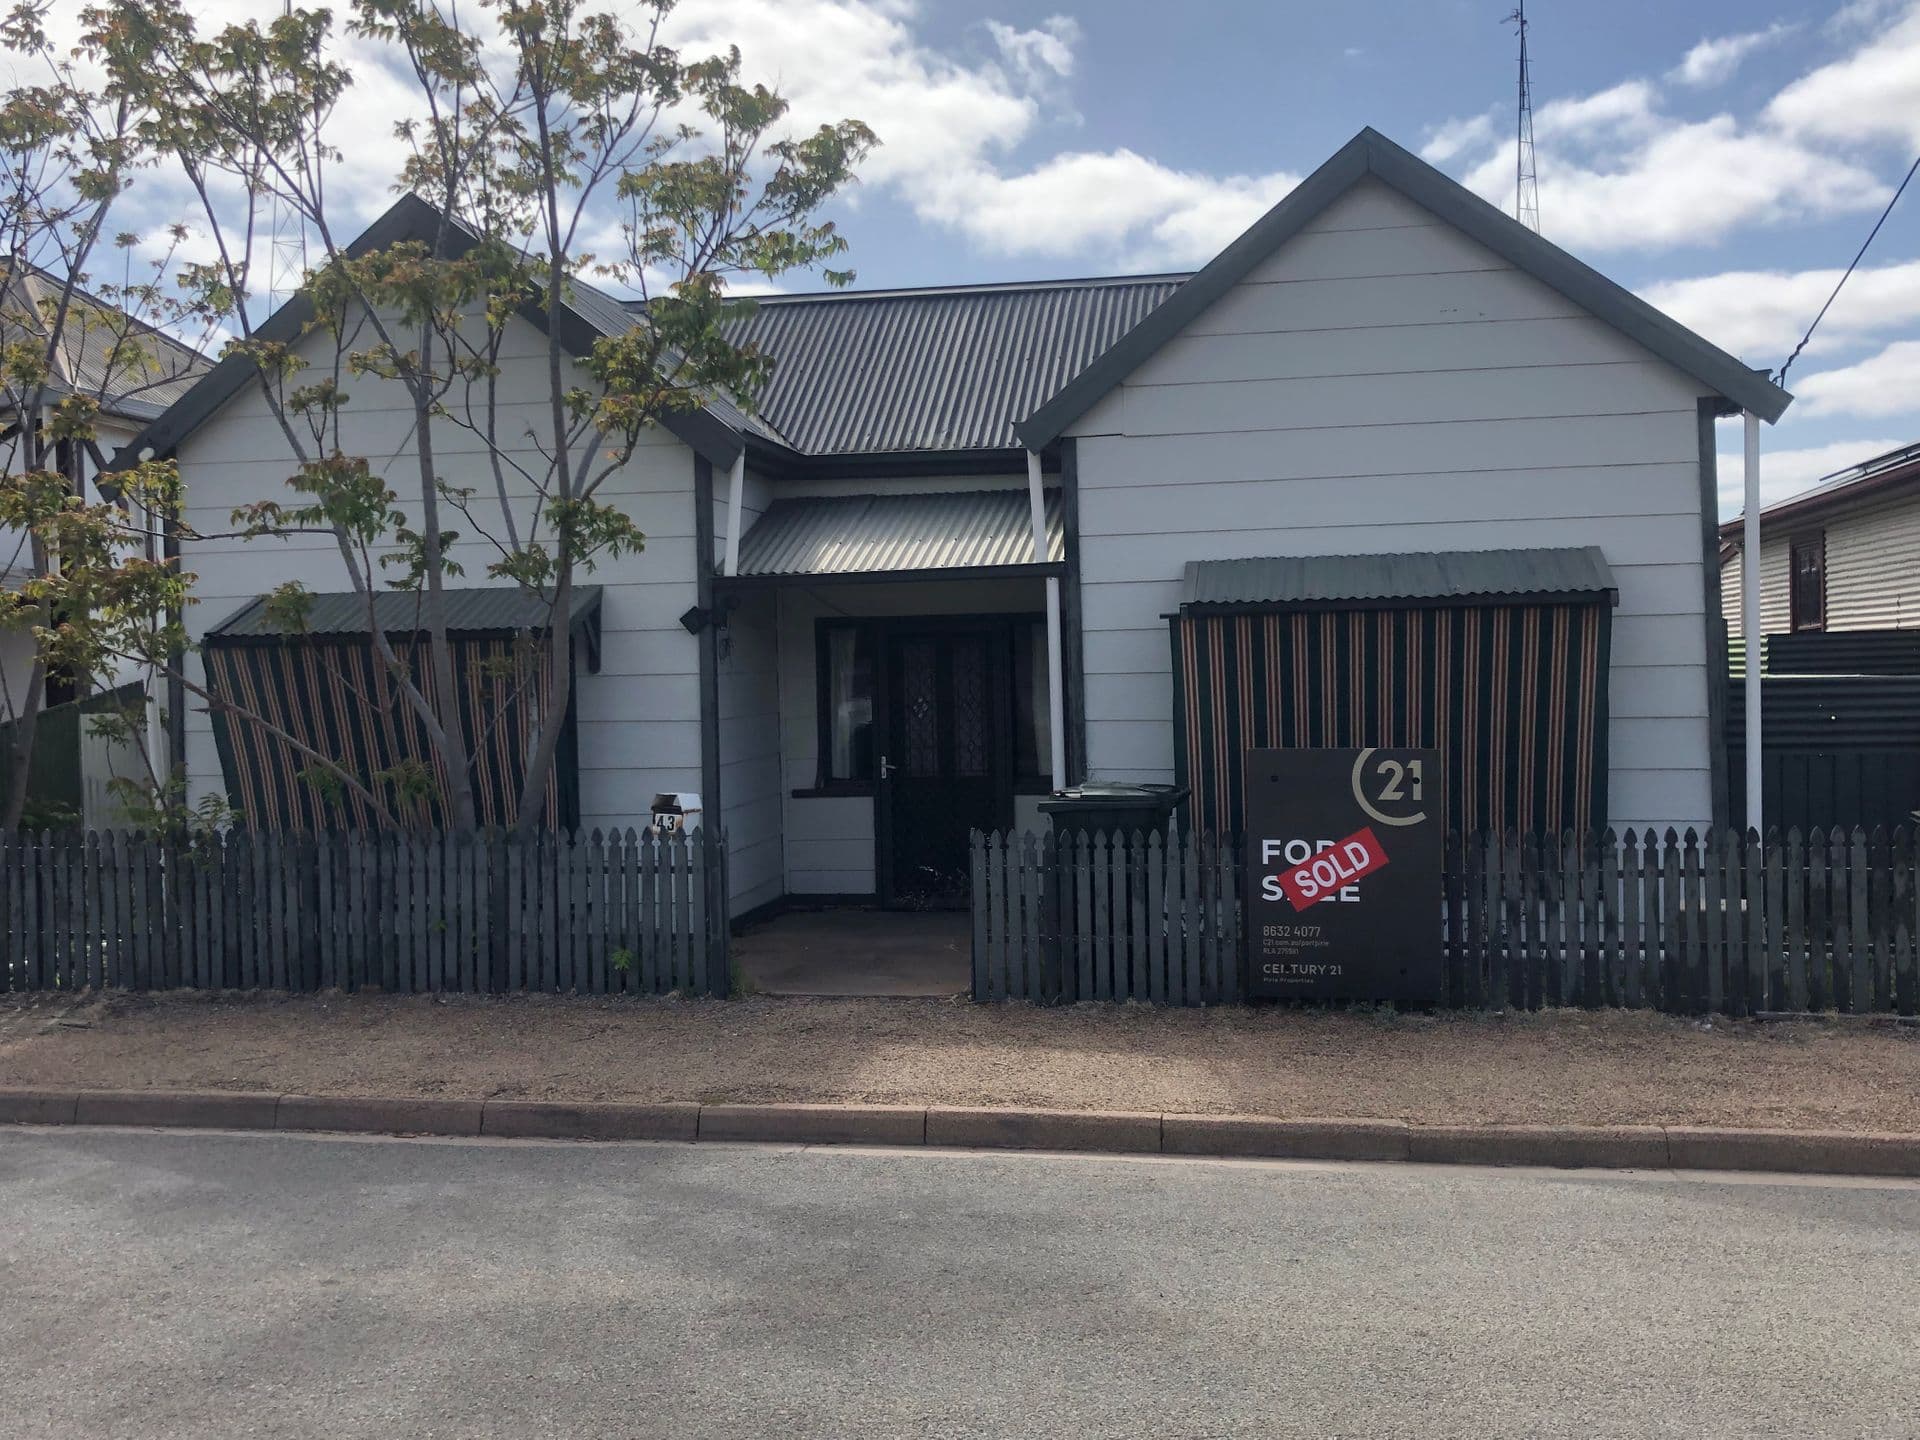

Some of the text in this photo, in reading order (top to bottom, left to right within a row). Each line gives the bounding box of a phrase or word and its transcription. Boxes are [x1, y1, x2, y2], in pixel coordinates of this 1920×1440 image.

[656, 815, 676, 831] 43
[1294, 841, 1370, 897] SOLD
[1262, 875, 1360, 902] SE
[1263, 925, 1321, 937] 8632 4077
[1329, 965, 1342, 975] 21
